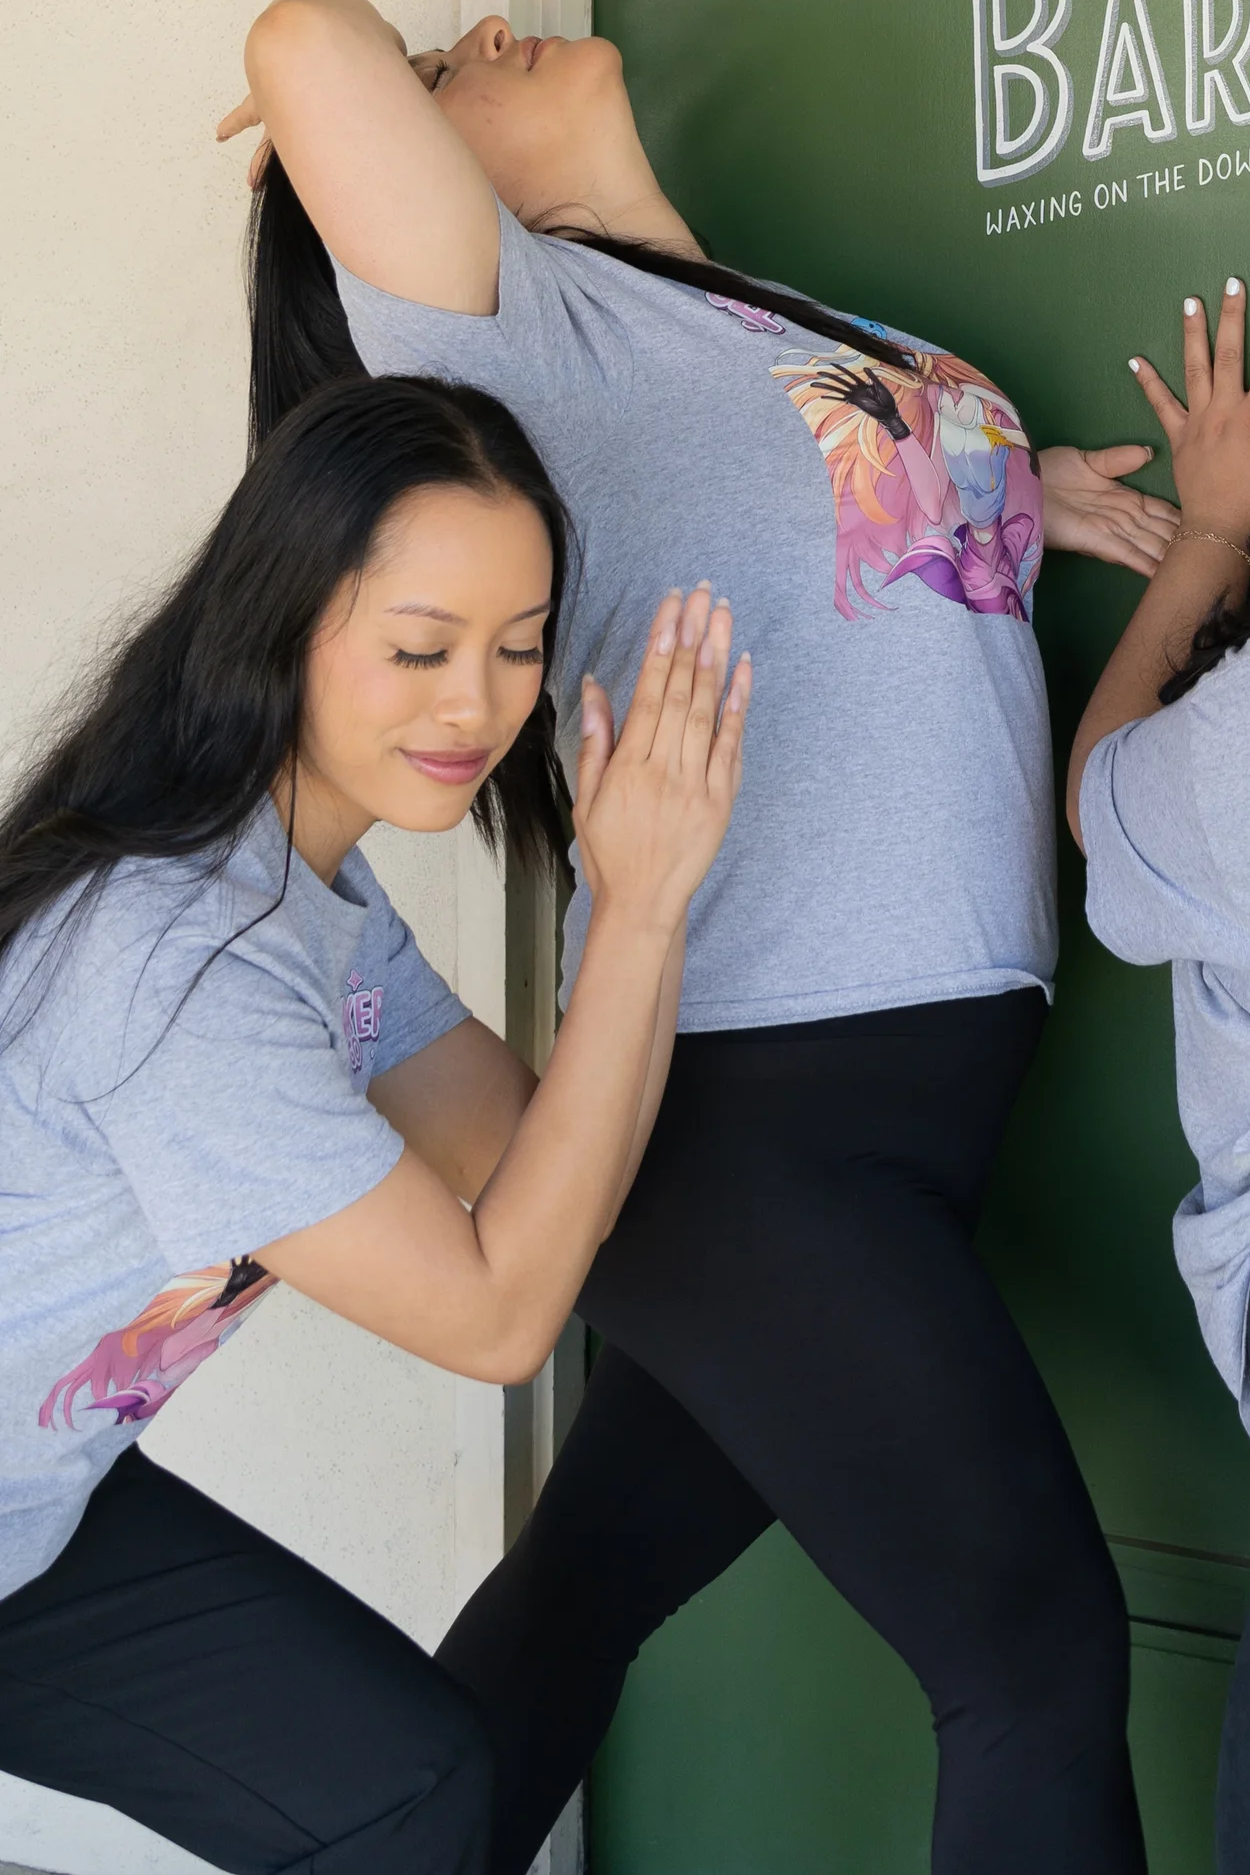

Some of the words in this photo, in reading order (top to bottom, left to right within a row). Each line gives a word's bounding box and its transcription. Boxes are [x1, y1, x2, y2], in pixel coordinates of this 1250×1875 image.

[985, 190, 1083, 237] WAXING
[1093, 178, 1129, 210] ON
[1136, 164, 1186, 199] THE
